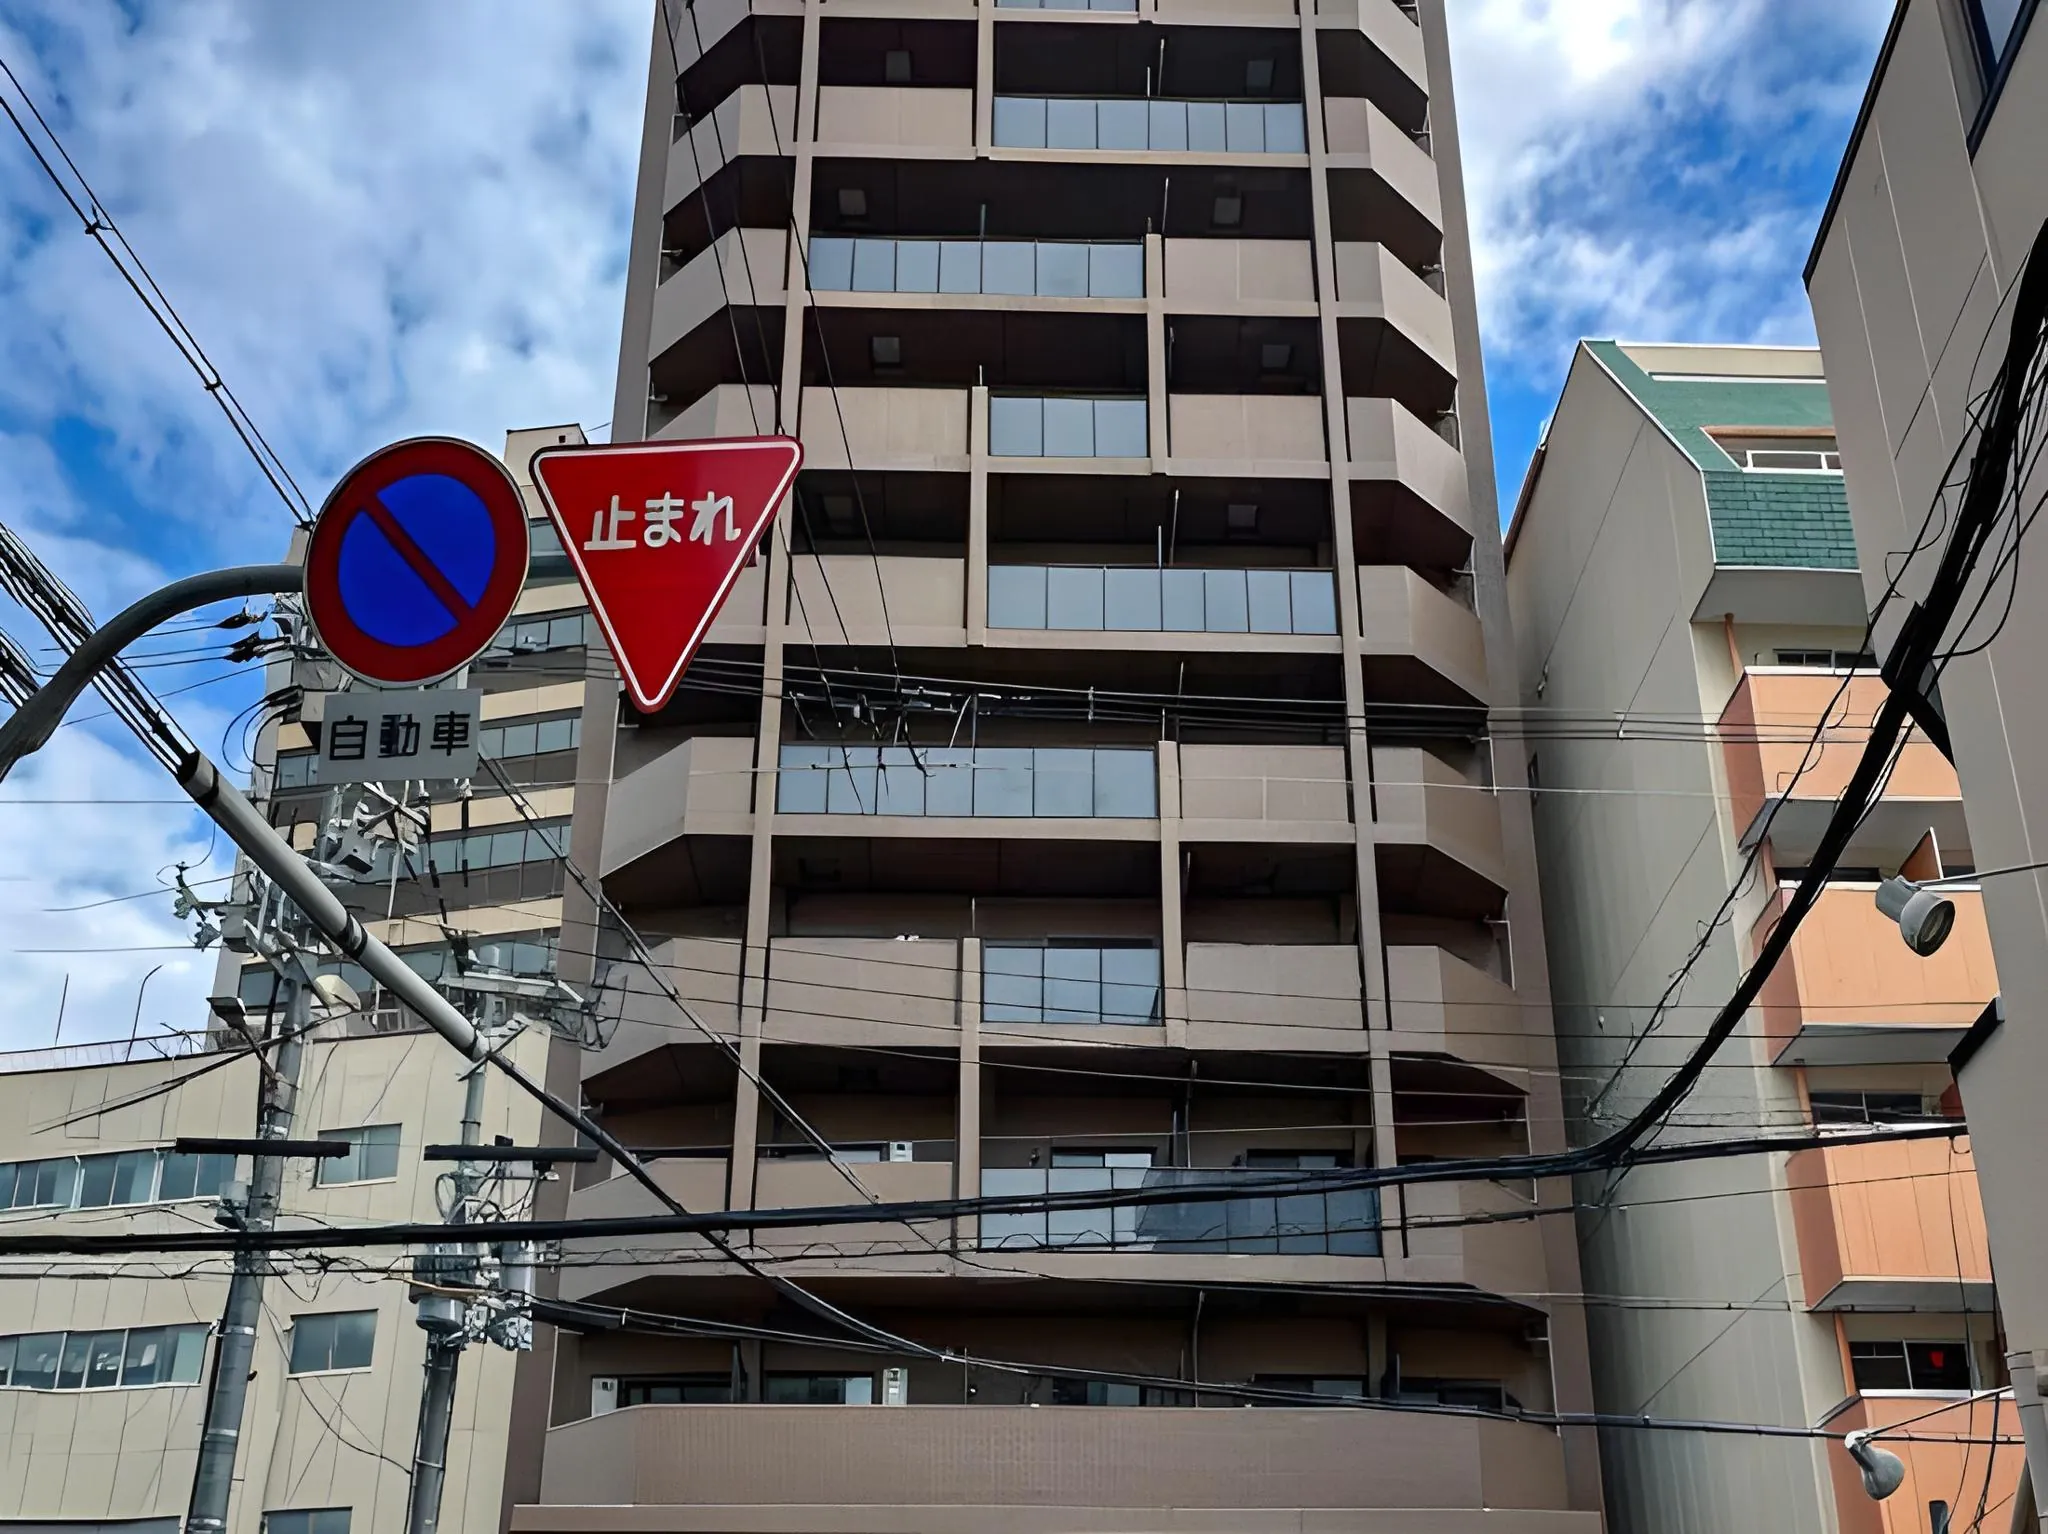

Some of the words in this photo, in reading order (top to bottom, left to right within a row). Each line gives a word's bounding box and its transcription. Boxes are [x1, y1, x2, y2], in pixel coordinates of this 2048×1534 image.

[584, 491, 741, 551] 止まれ
[329, 710, 471, 761] 自動車
